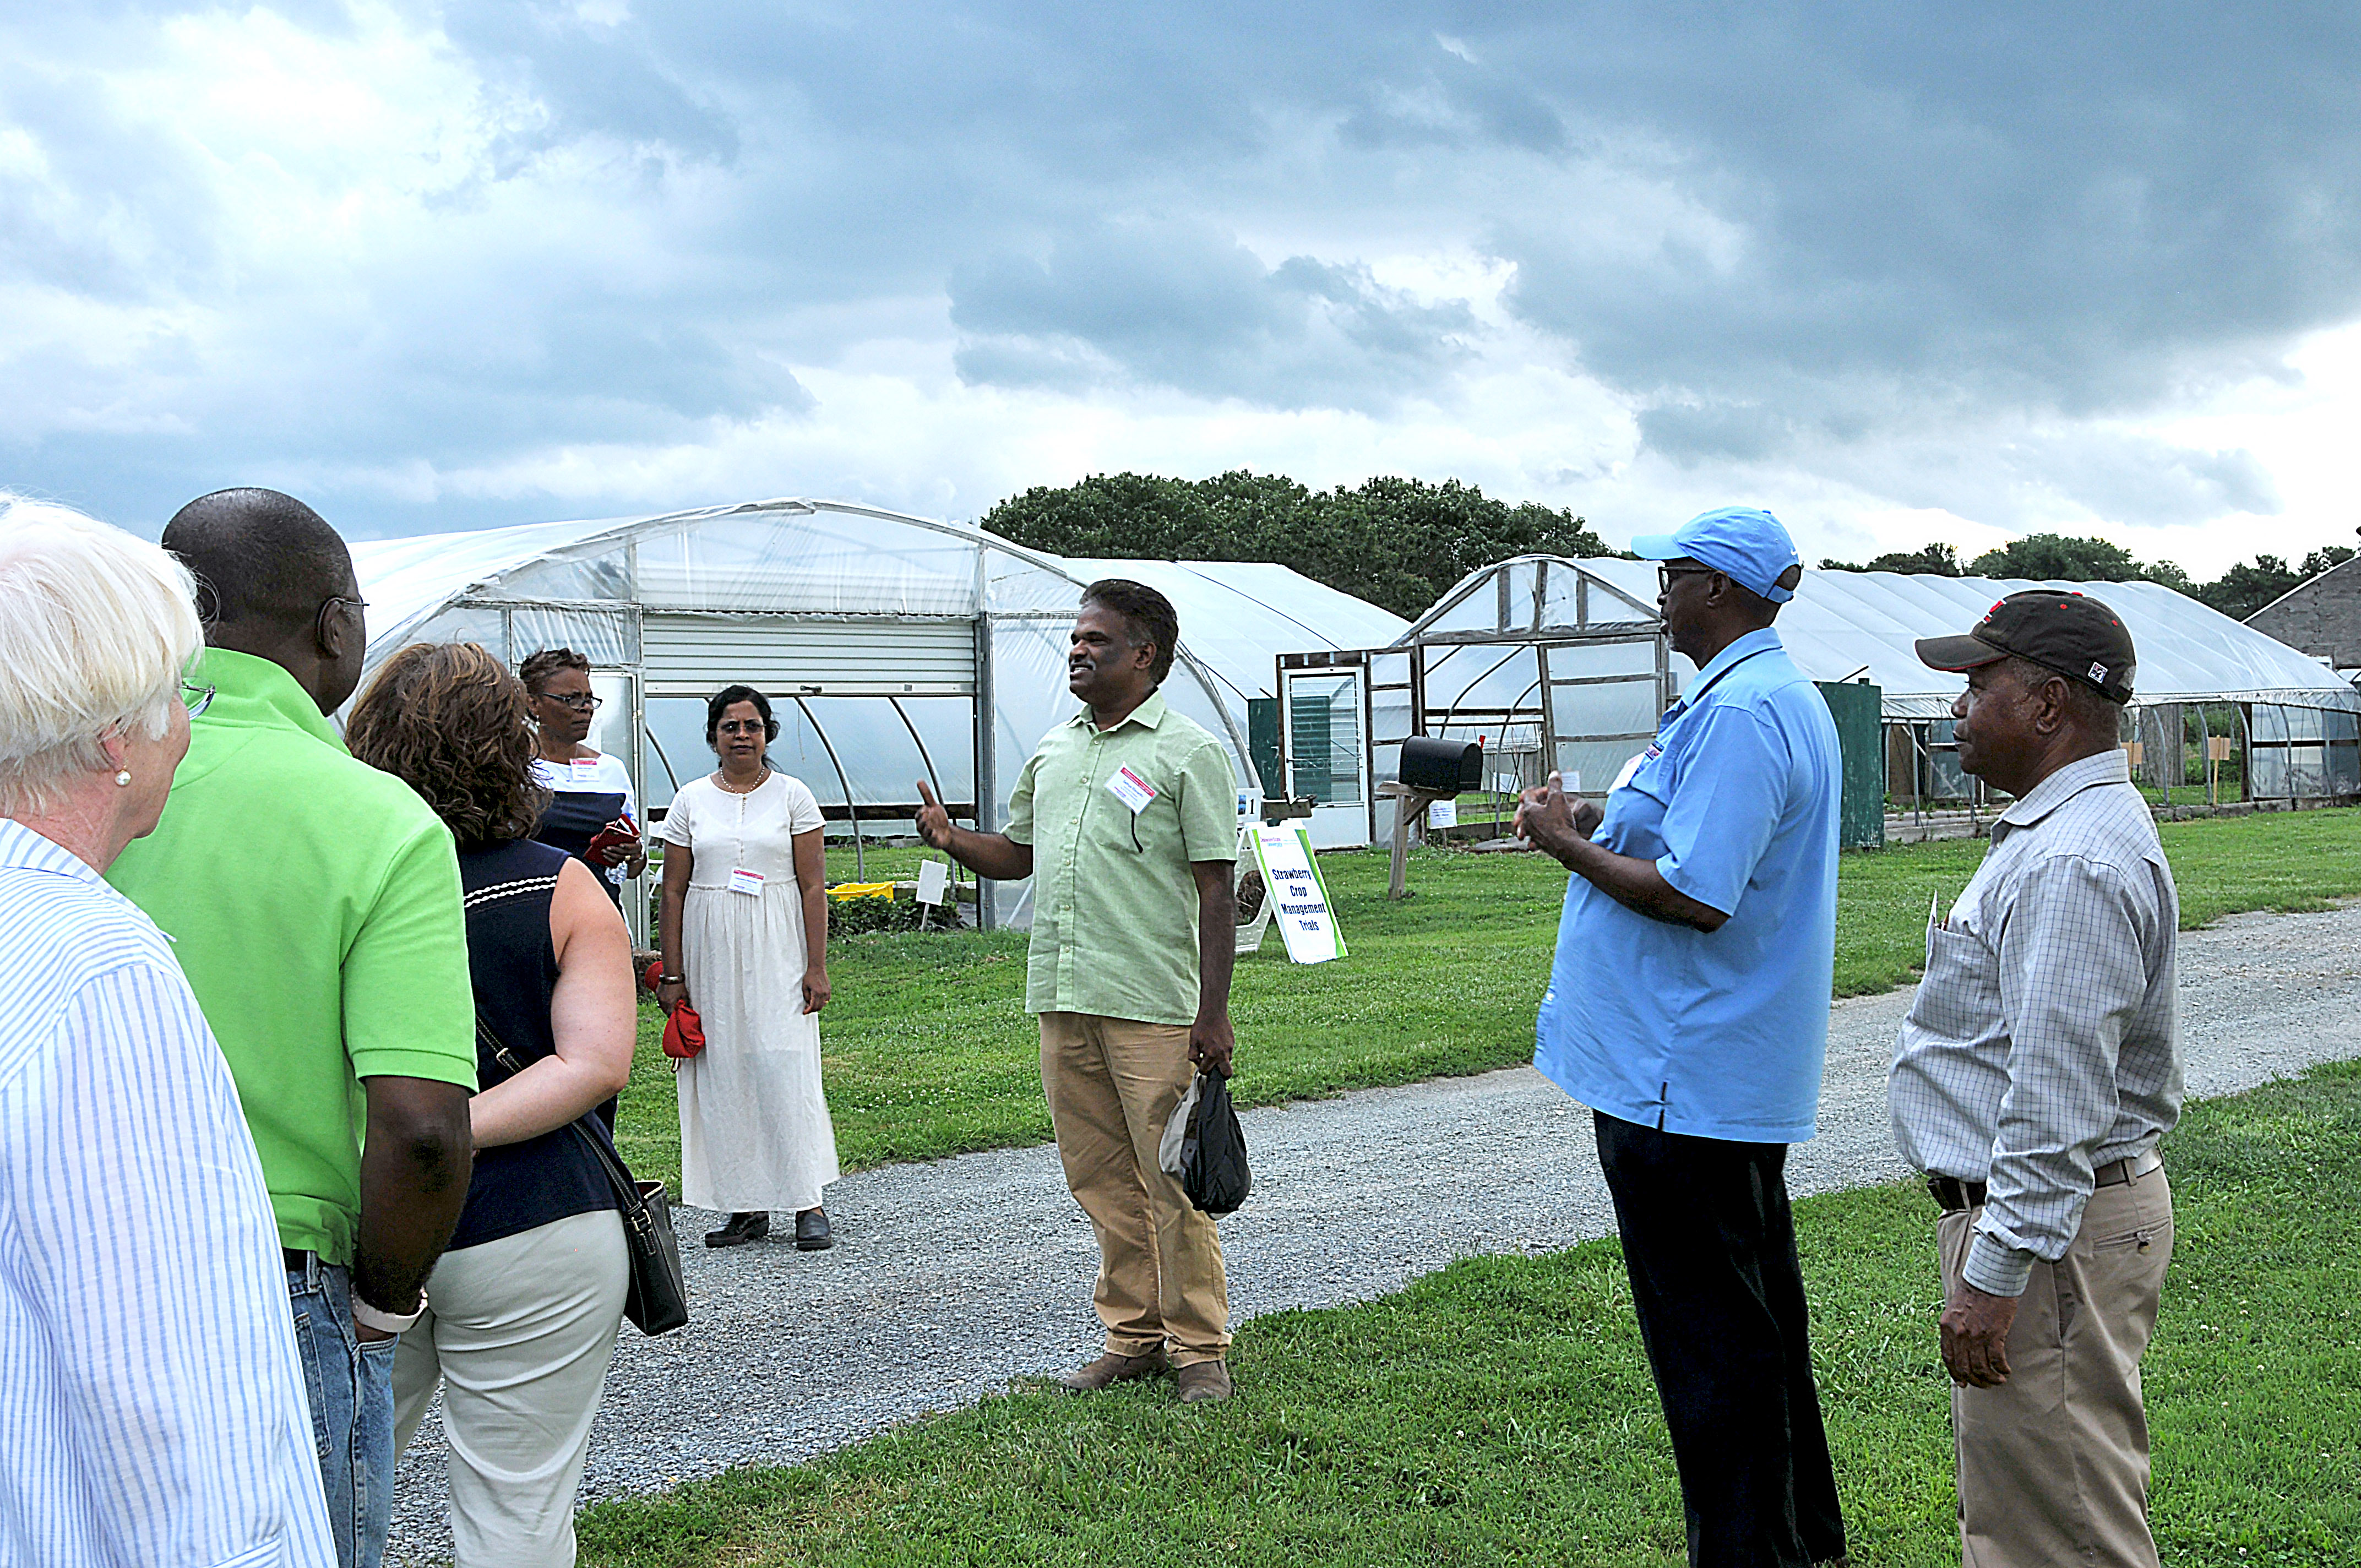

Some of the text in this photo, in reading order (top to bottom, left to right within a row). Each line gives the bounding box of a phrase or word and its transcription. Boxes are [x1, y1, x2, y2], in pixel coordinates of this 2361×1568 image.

[1272, 868, 1312, 880] Strawberry
[1290, 885, 1307, 897] Crop
[1281, 902, 1326, 915] Management
[1299, 920, 1319, 931] Trials
